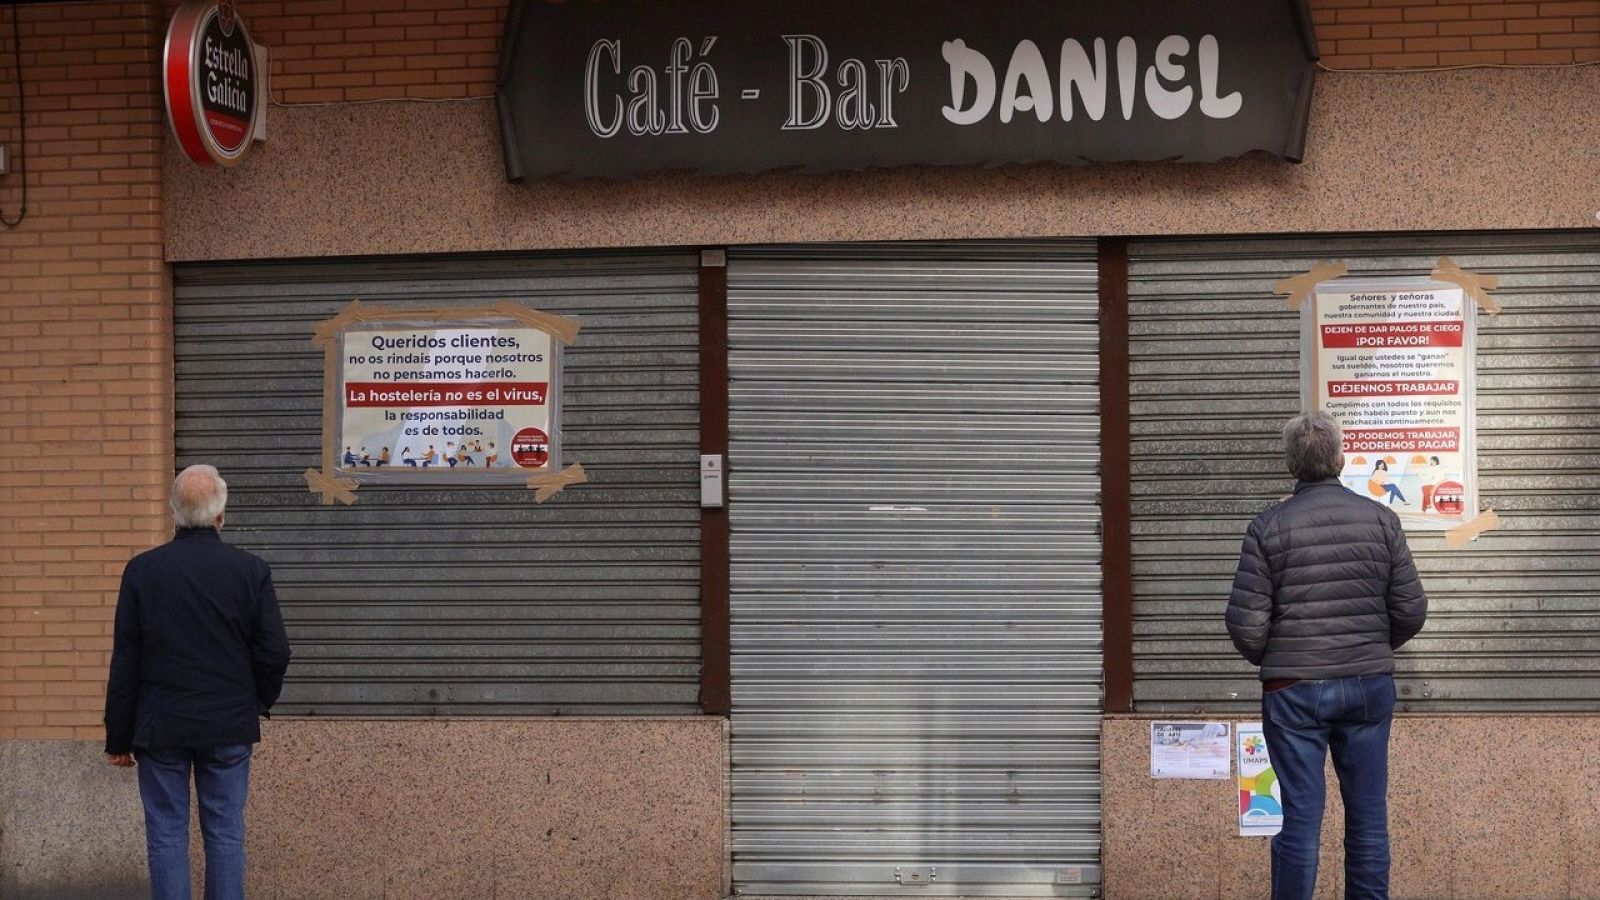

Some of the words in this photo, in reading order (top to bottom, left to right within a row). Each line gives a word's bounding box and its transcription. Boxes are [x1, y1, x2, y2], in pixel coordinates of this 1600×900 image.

[205, 36, 249, 81] Estrella
[584, 36, 720, 138] Café
[780, 34, 910, 131] Bar
[941, 34, 1243, 125] DANIEL
[207, 71, 246, 113] Galicia
[1350, 294, 1386, 302] Señores
[1390, 294, 1396, 302] y
[1338, 303, 1386, 311] gobernantes
[1324, 326, 1352, 334] DEJEN
[1420, 324, 1432, 332] DE
[1434, 324, 1461, 332] CIEGO
[372, 335, 446, 350] Queridos
[450, 334, 520, 349] clientes,
[1356, 337, 1384, 346] ¡POR
[1387, 336, 1430, 345] FAVOR!
[350, 355, 365, 364] no
[368, 355, 383, 364] os
[387, 352, 430, 364] rindais
[434, 355, 482, 366] porque
[486, 352, 544, 363] nosotros
[1337, 354, 1357, 362] Igual
[1346, 362, 1378, 370] sueldos,
[374, 370, 390, 380] no
[394, 370, 462, 381] pensamos
[466, 368, 516, 379] hacerlo.
[1332, 382, 1392, 393] DÉJENNOS
[1396, 383, 1455, 392] TRABAJAR
[350, 390, 366, 402] La
[370, 389, 441, 402] hostelería
[446, 391, 463, 401] no
[466, 391, 482, 400] es
[486, 388, 500, 400] el
[503, 388, 543, 402] virus,
[1388, 400, 1409, 408] todos
[1424, 400, 1462, 408] requisitos
[385, 410, 396, 420] la
[400, 409, 504, 422] responsabilidad
[1332, 410, 1346, 418] que
[1364, 408, 1390, 416] habéis
[404, 427, 419, 436] es
[422, 425, 440, 436] de
[442, 425, 483, 436] todos.
[1358, 432, 1404, 440] PODEMOS
[1406, 431, 1457, 440] TRABAJAR,
[1353, 442, 1416, 450] PODREMOS
[1418, 440, 1456, 449] PAGAR
